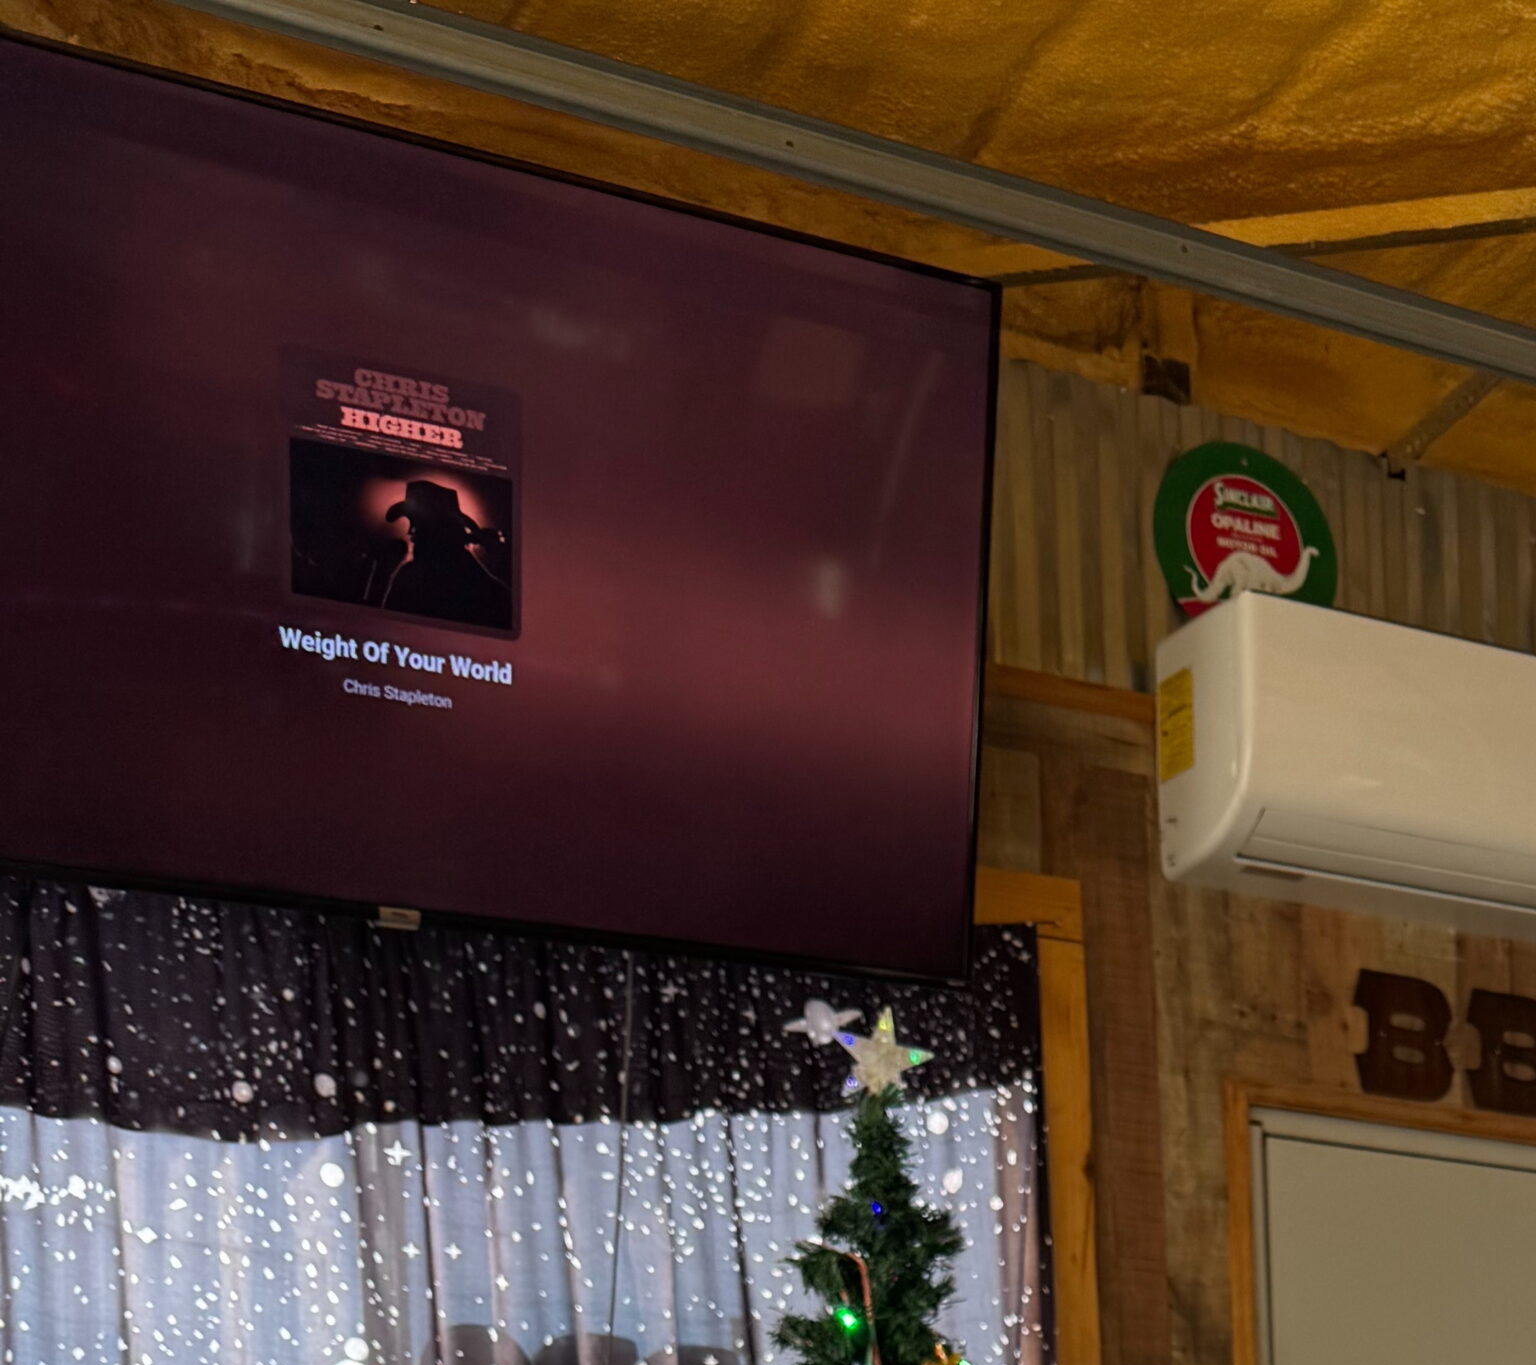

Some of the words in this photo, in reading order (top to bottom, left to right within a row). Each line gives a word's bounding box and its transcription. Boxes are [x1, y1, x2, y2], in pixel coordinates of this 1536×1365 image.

[353, 367, 449, 402] CHRIS
[315, 378, 486, 431] STAPLETON
[340, 405, 463, 449] HIGHER
[1210, 511, 1281, 540] OPALINE
[278, 626, 358, 661] Weight
[363, 640, 392, 664] Of
[395, 645, 446, 675] Your
[450, 655, 513, 685] World
[342, 678, 381, 699] Chris
[384, 685, 453, 709] Stapleton
